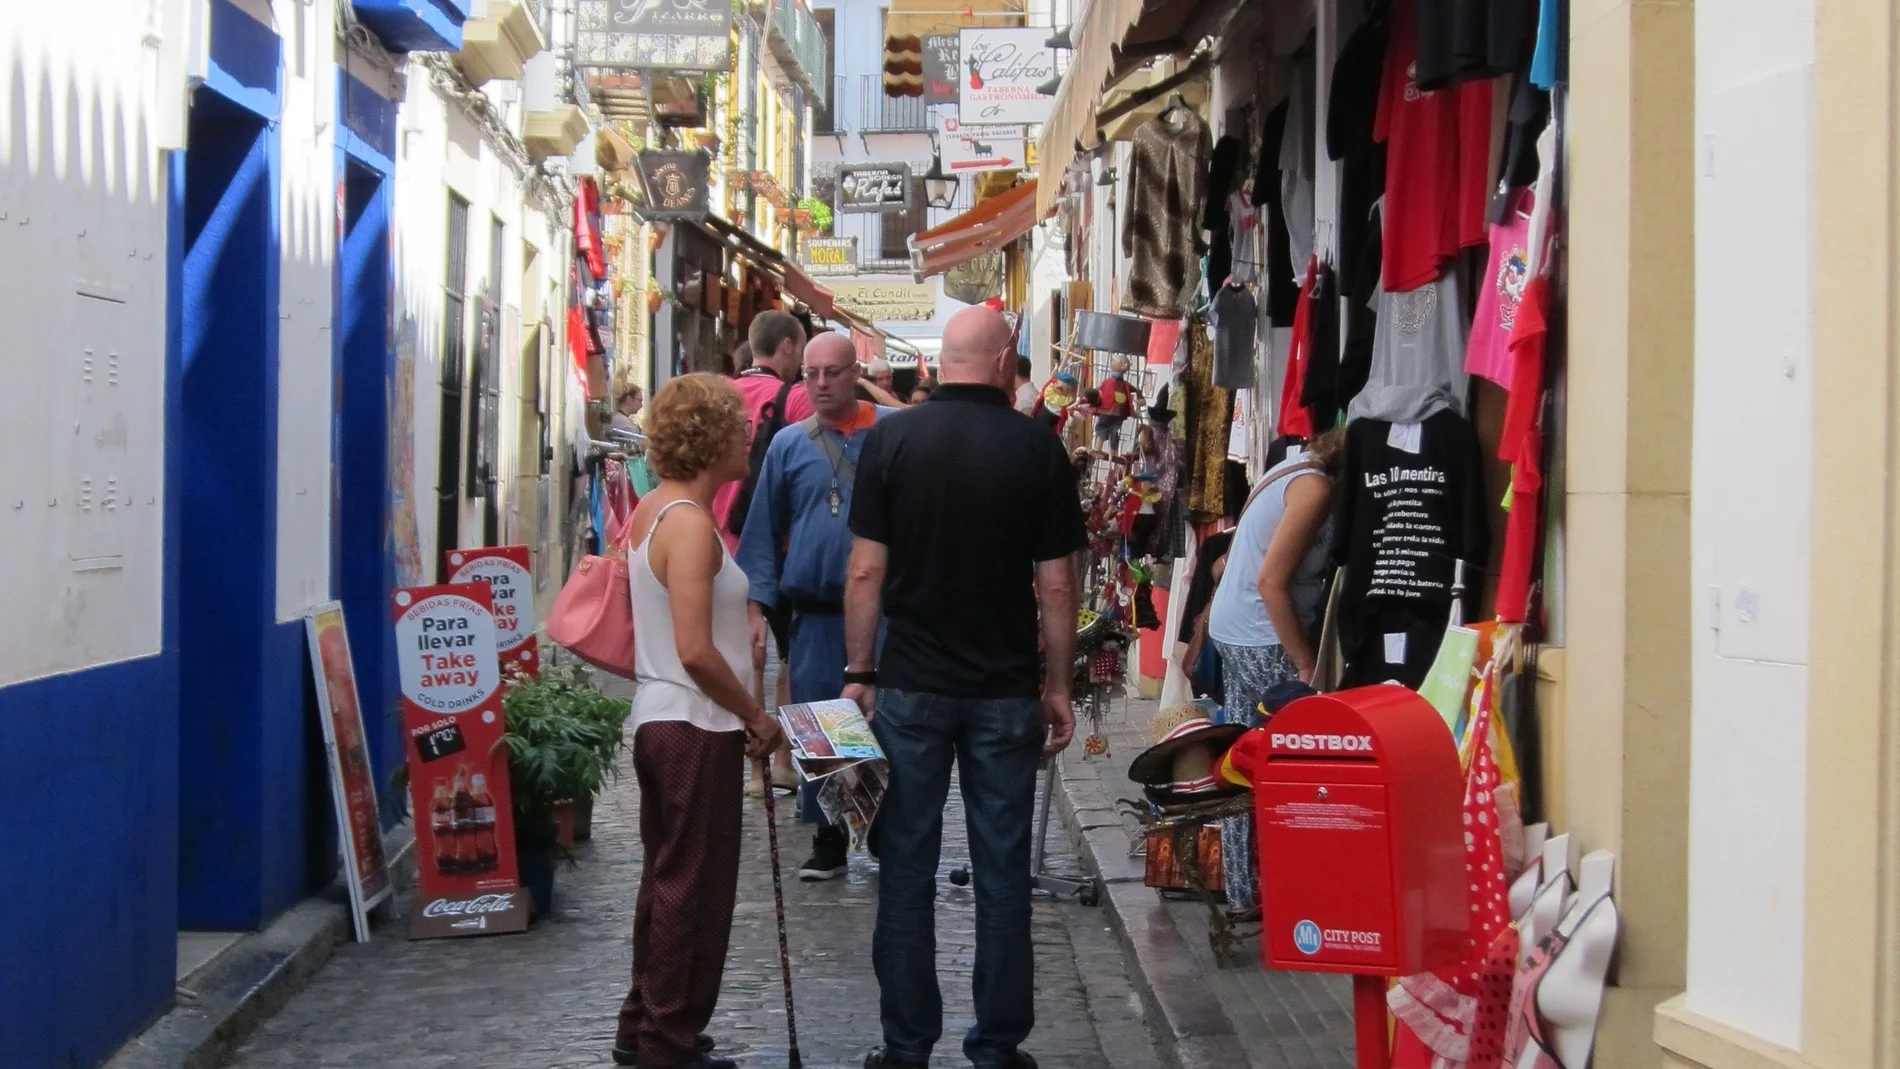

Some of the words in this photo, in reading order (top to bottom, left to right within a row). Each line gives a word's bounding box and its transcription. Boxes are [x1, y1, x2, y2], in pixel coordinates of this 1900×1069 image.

[852, 169, 888, 177] TABERNA
[663, 187, 696, 208] DEANES
[807, 238, 852, 248] SOUVENIRS
[810, 247, 849, 264] MORAL
[857, 287, 868, 299] El
[1364, 472, 1387, 488] Las
[1389, 466, 1399, 483] 10
[1394, 510, 1429, 519] cobertura
[1428, 536, 1445, 545] vida
[1395, 547, 1400, 555] 5
[460, 560, 494, 577] BEBIDAS
[1396, 560, 1416, 568] pago
[1385, 578, 1407, 586] acabo
[1405, 590, 1421, 598] juro
[407, 599, 450, 620] BEBIDAS
[494, 602, 515, 616] ke
[422, 617, 468, 632] Para
[418, 634, 475, 650] llevar
[496, 633, 523, 648] RINKS
[421, 652, 476, 671] Take
[421, 670, 479, 687] away
[417, 693, 445, 708] COLD
[448, 688, 484, 709] DRINKS
[411, 725, 430, 736] POR
[431, 716, 456, 730] SOLO
[1271, 733, 1373, 751] POSTBOX
[1323, 929, 1349, 943] CITY
[1351, 931, 1381, 945] POST
